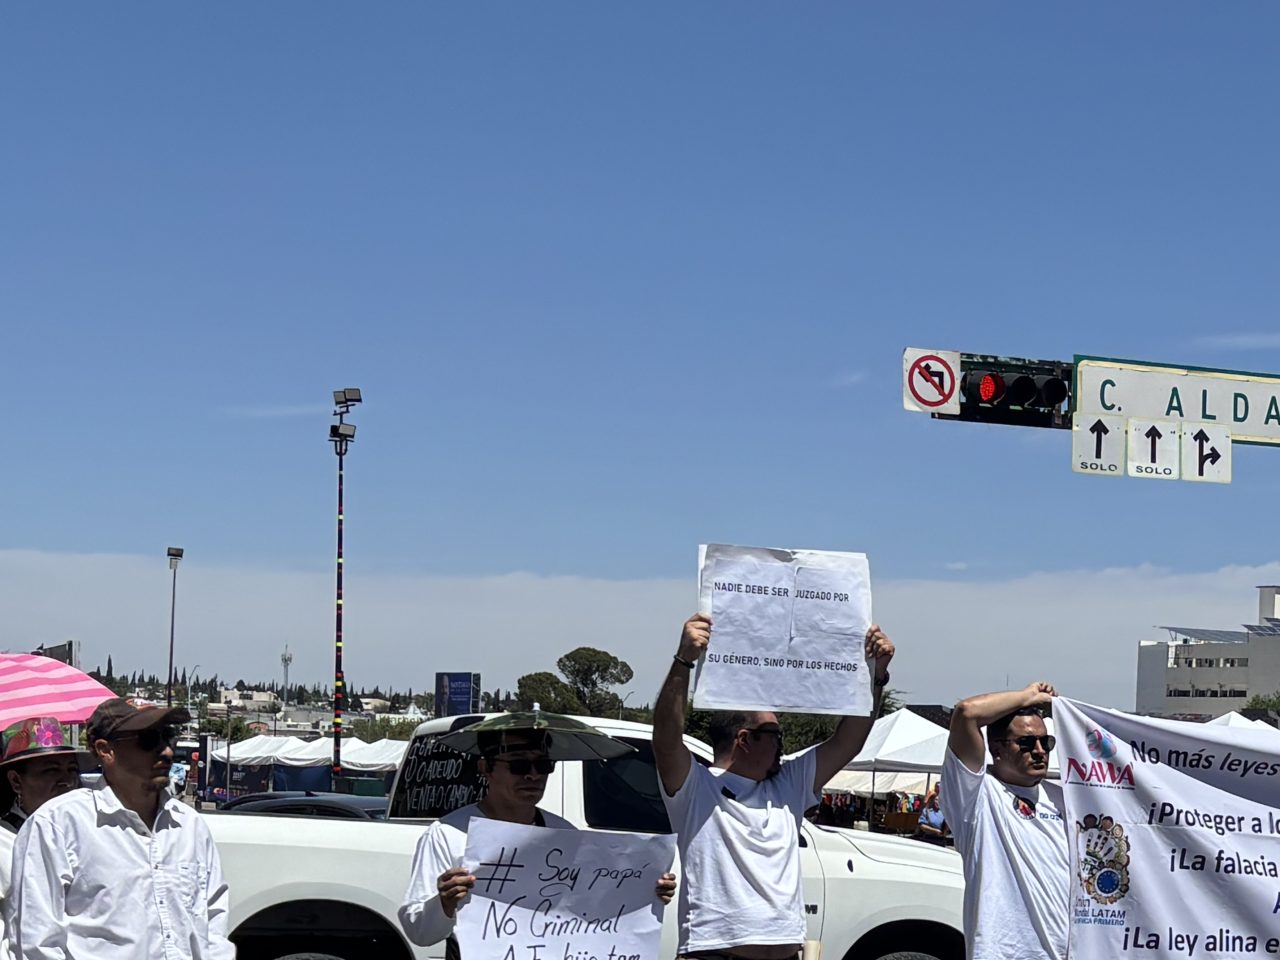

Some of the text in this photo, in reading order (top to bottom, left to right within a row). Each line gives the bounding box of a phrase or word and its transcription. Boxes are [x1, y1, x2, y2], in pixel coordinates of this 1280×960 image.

[1099, 379, 1122, 412] C.
[1080, 461, 1118, 472] SOLO
[1135, 465, 1172, 476] SOLO
[714, 582, 849, 602] NADIE DEBE SER JUZGADO POR
[708, 651, 858, 672] SU GÉNERO, SINO POR LOS HECHOS
[1065, 757, 1136, 786] NAWA
[1131, 740, 1160, 765] No
[1167, 748, 1213, 770] más
[1220, 751, 1279, 779] leyes
[1147, 802, 1246, 836] ¡Proteger
[1251, 816, 1263, 834] a
[538, 848, 581, 898] Soy
[588, 862, 651, 890] papá
[1170, 848, 1207, 873] ¡La
[1215, 850, 1279, 878] falacia
[482, 895, 626, 940] No Criminal
[1092, 908, 1126, 919] LATAM
[1122, 926, 1160, 951] ¡La
[1168, 927, 1199, 957] ley
[1205, 928, 1258, 953] alina
